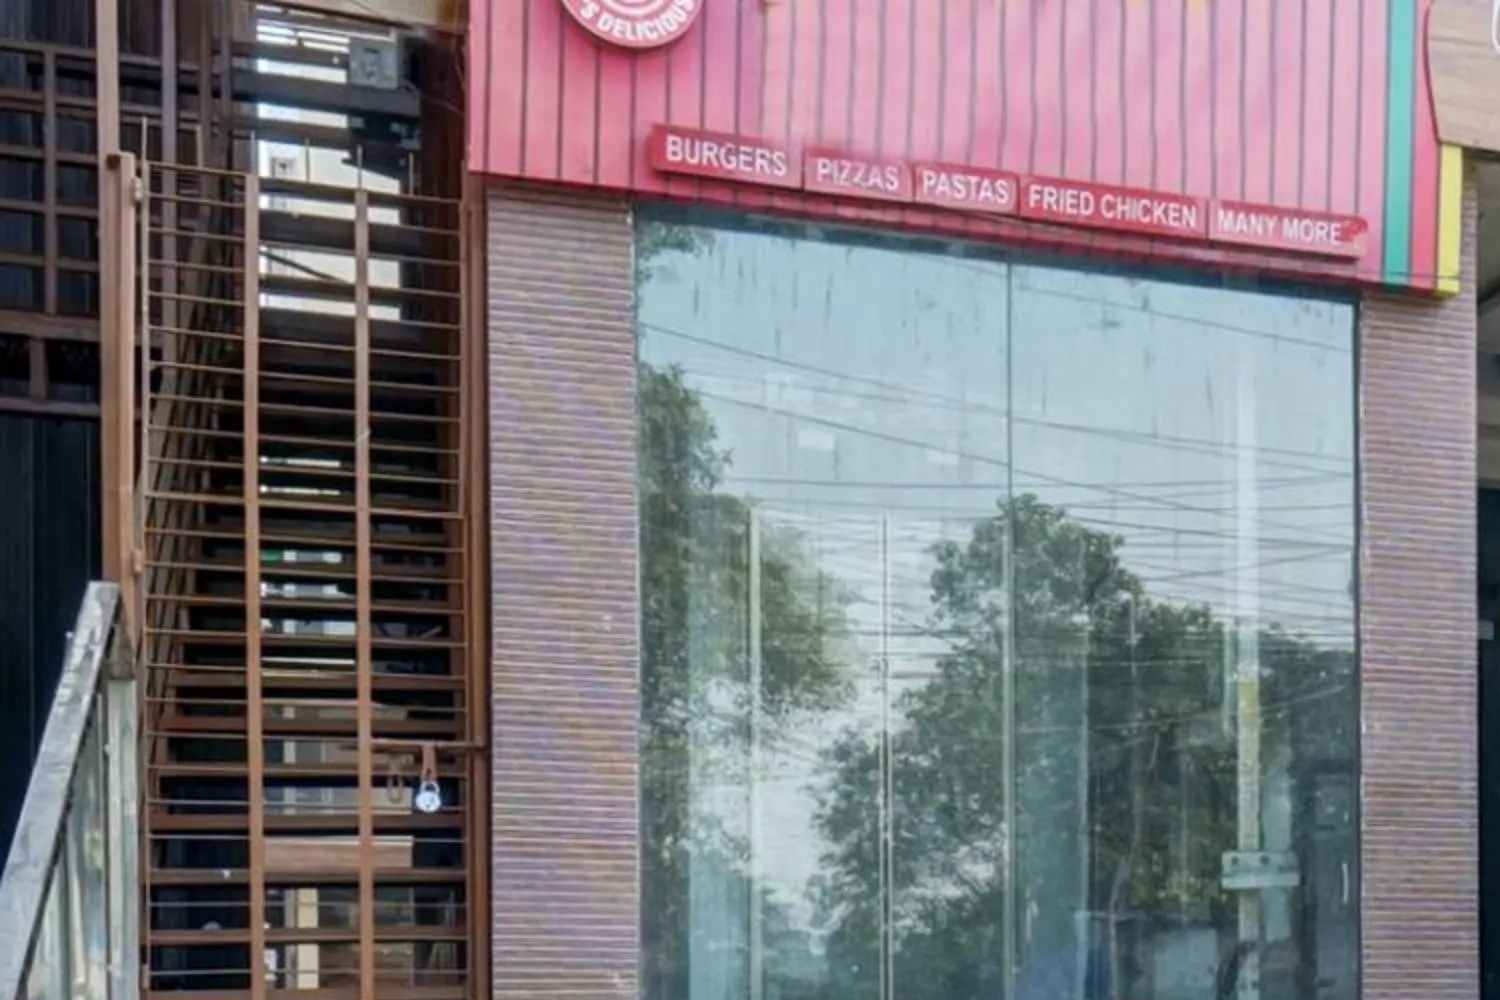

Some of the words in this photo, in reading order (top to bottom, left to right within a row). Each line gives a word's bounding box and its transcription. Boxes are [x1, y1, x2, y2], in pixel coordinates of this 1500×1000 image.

[597, 0, 695, 41] DELICIOUS
[665, 133, 787, 177] BURGERS
[816, 157, 899, 191] PIZZAS
[922, 169, 1009, 205] PASTAS
[1028, 184, 1094, 217] FRIED
[1100, 194, 1197, 230] CHICKEN
[1216, 209, 1276, 236] MANY
[1283, 216, 1342, 245] MORE
